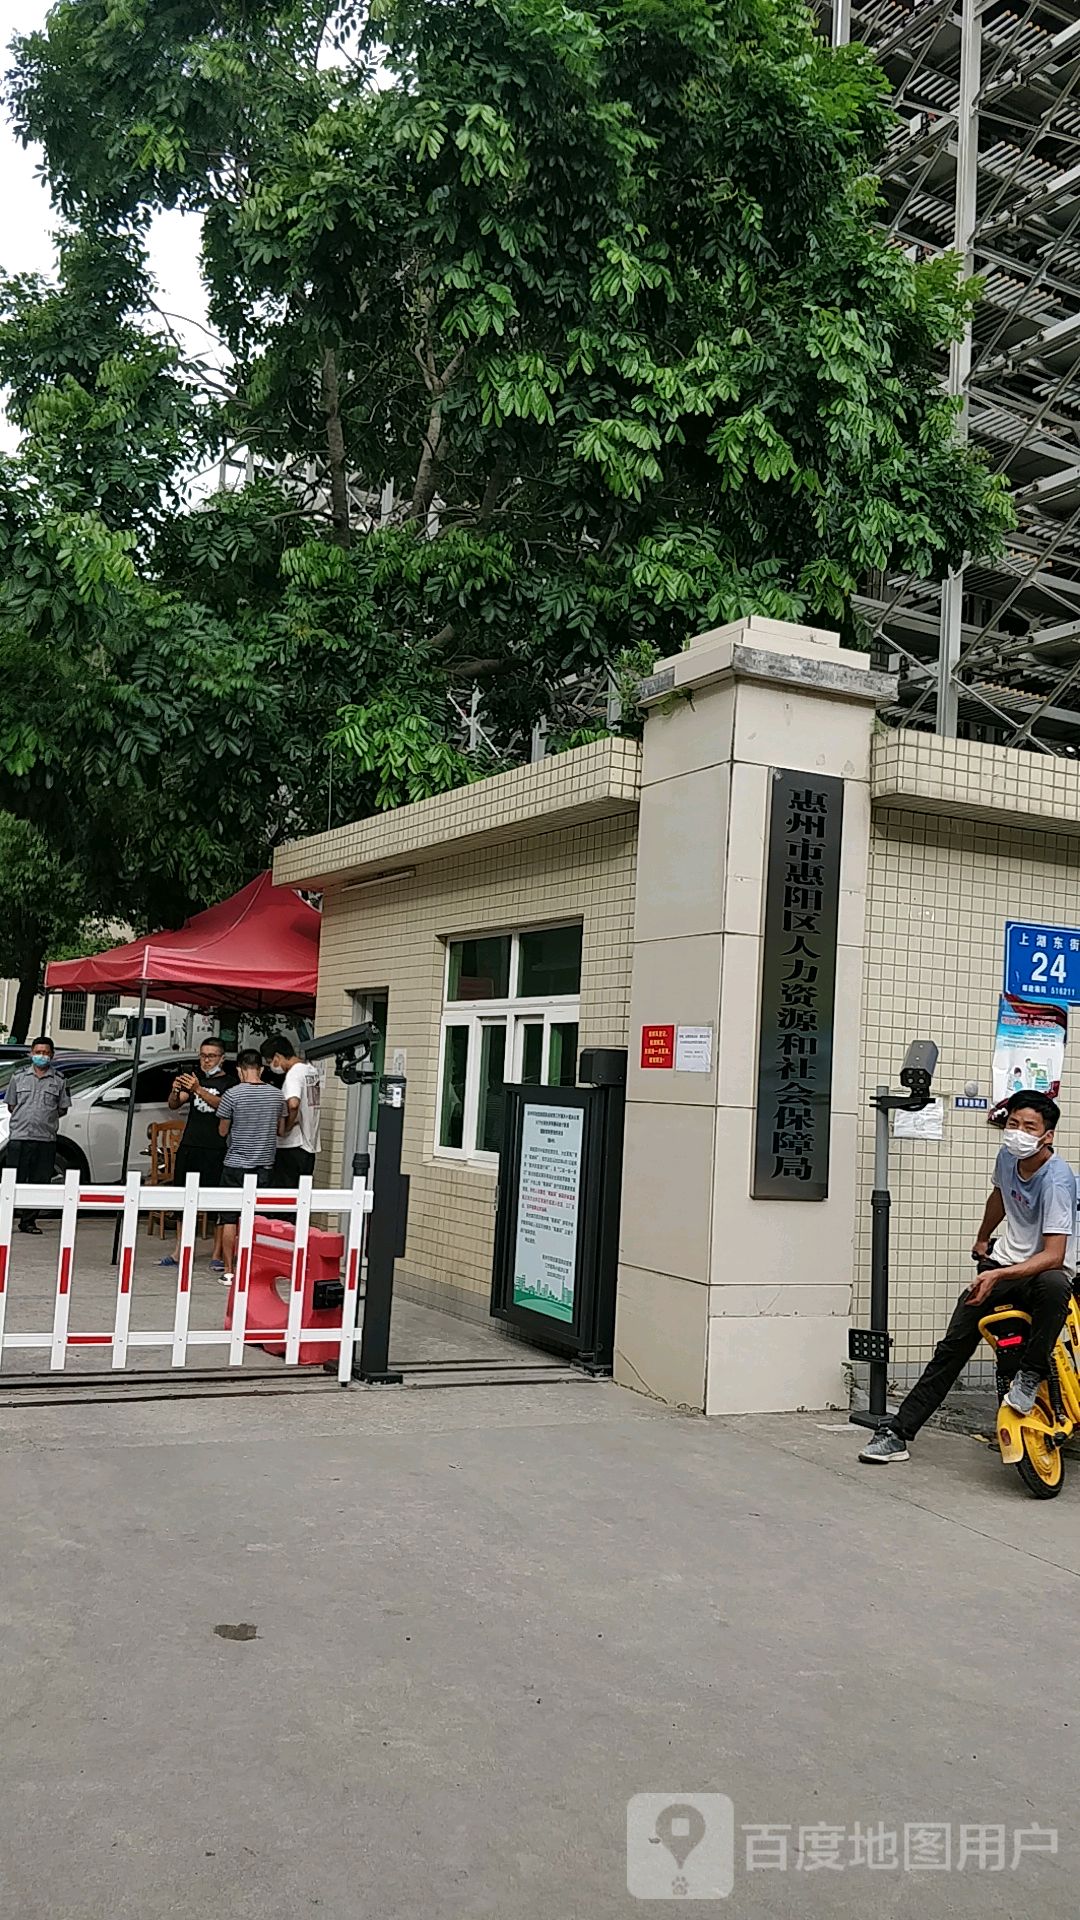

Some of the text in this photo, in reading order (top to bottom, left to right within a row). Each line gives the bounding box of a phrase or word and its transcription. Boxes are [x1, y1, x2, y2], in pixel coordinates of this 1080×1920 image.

[1018, 932, 1080, 952] 上湖东街
[1031, 951, 1067, 984] 24
[770, 787, 828, 1182] 惠州市惠阳区人力资源和社会保障局
